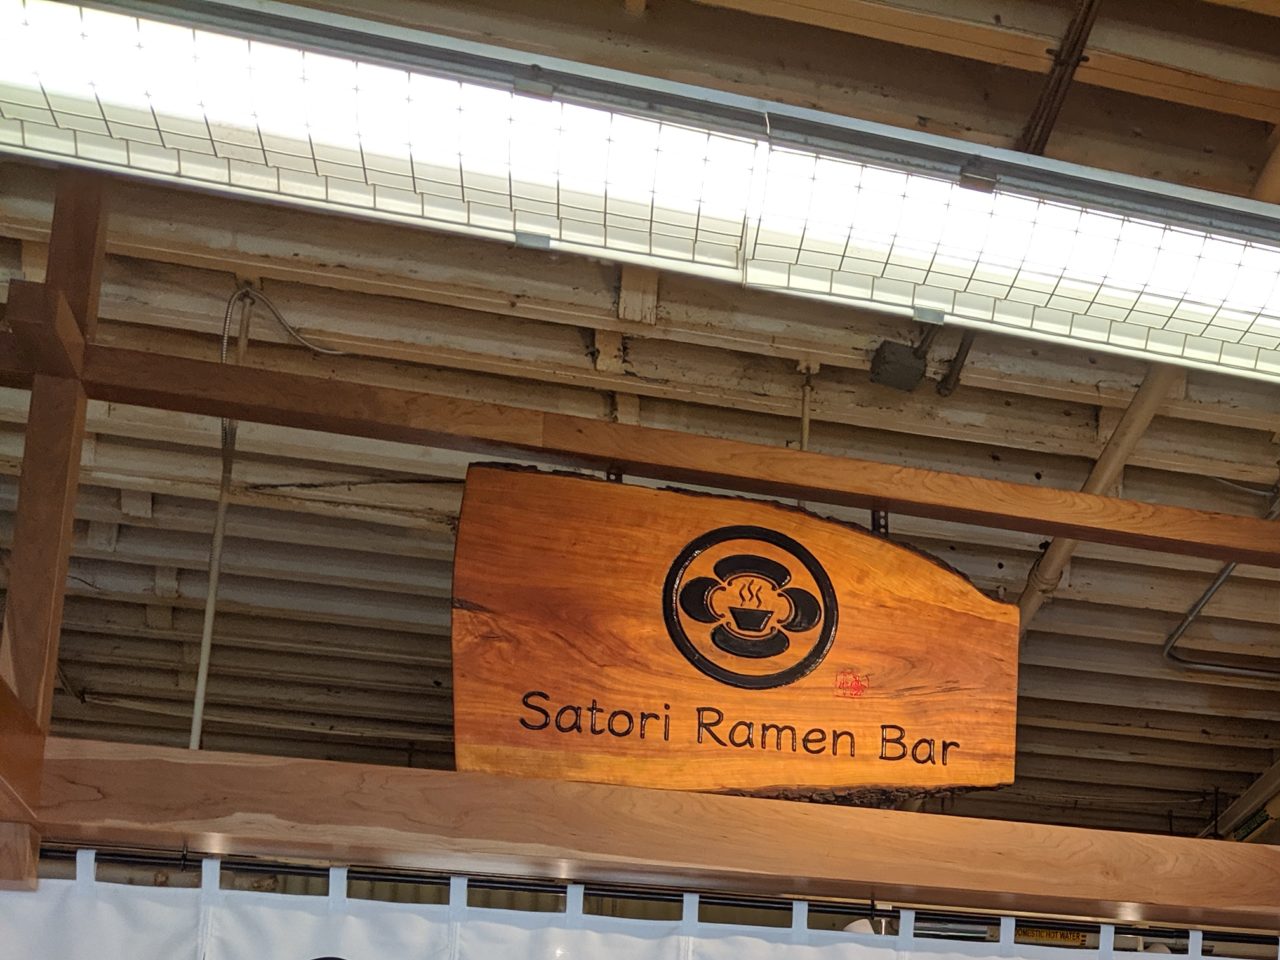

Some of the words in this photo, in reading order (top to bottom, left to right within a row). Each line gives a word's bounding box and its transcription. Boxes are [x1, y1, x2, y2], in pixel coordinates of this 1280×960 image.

[519, 689, 672, 742] Satori
[696, 706, 856, 758] Ramen
[879, 723, 961, 768] Bar
